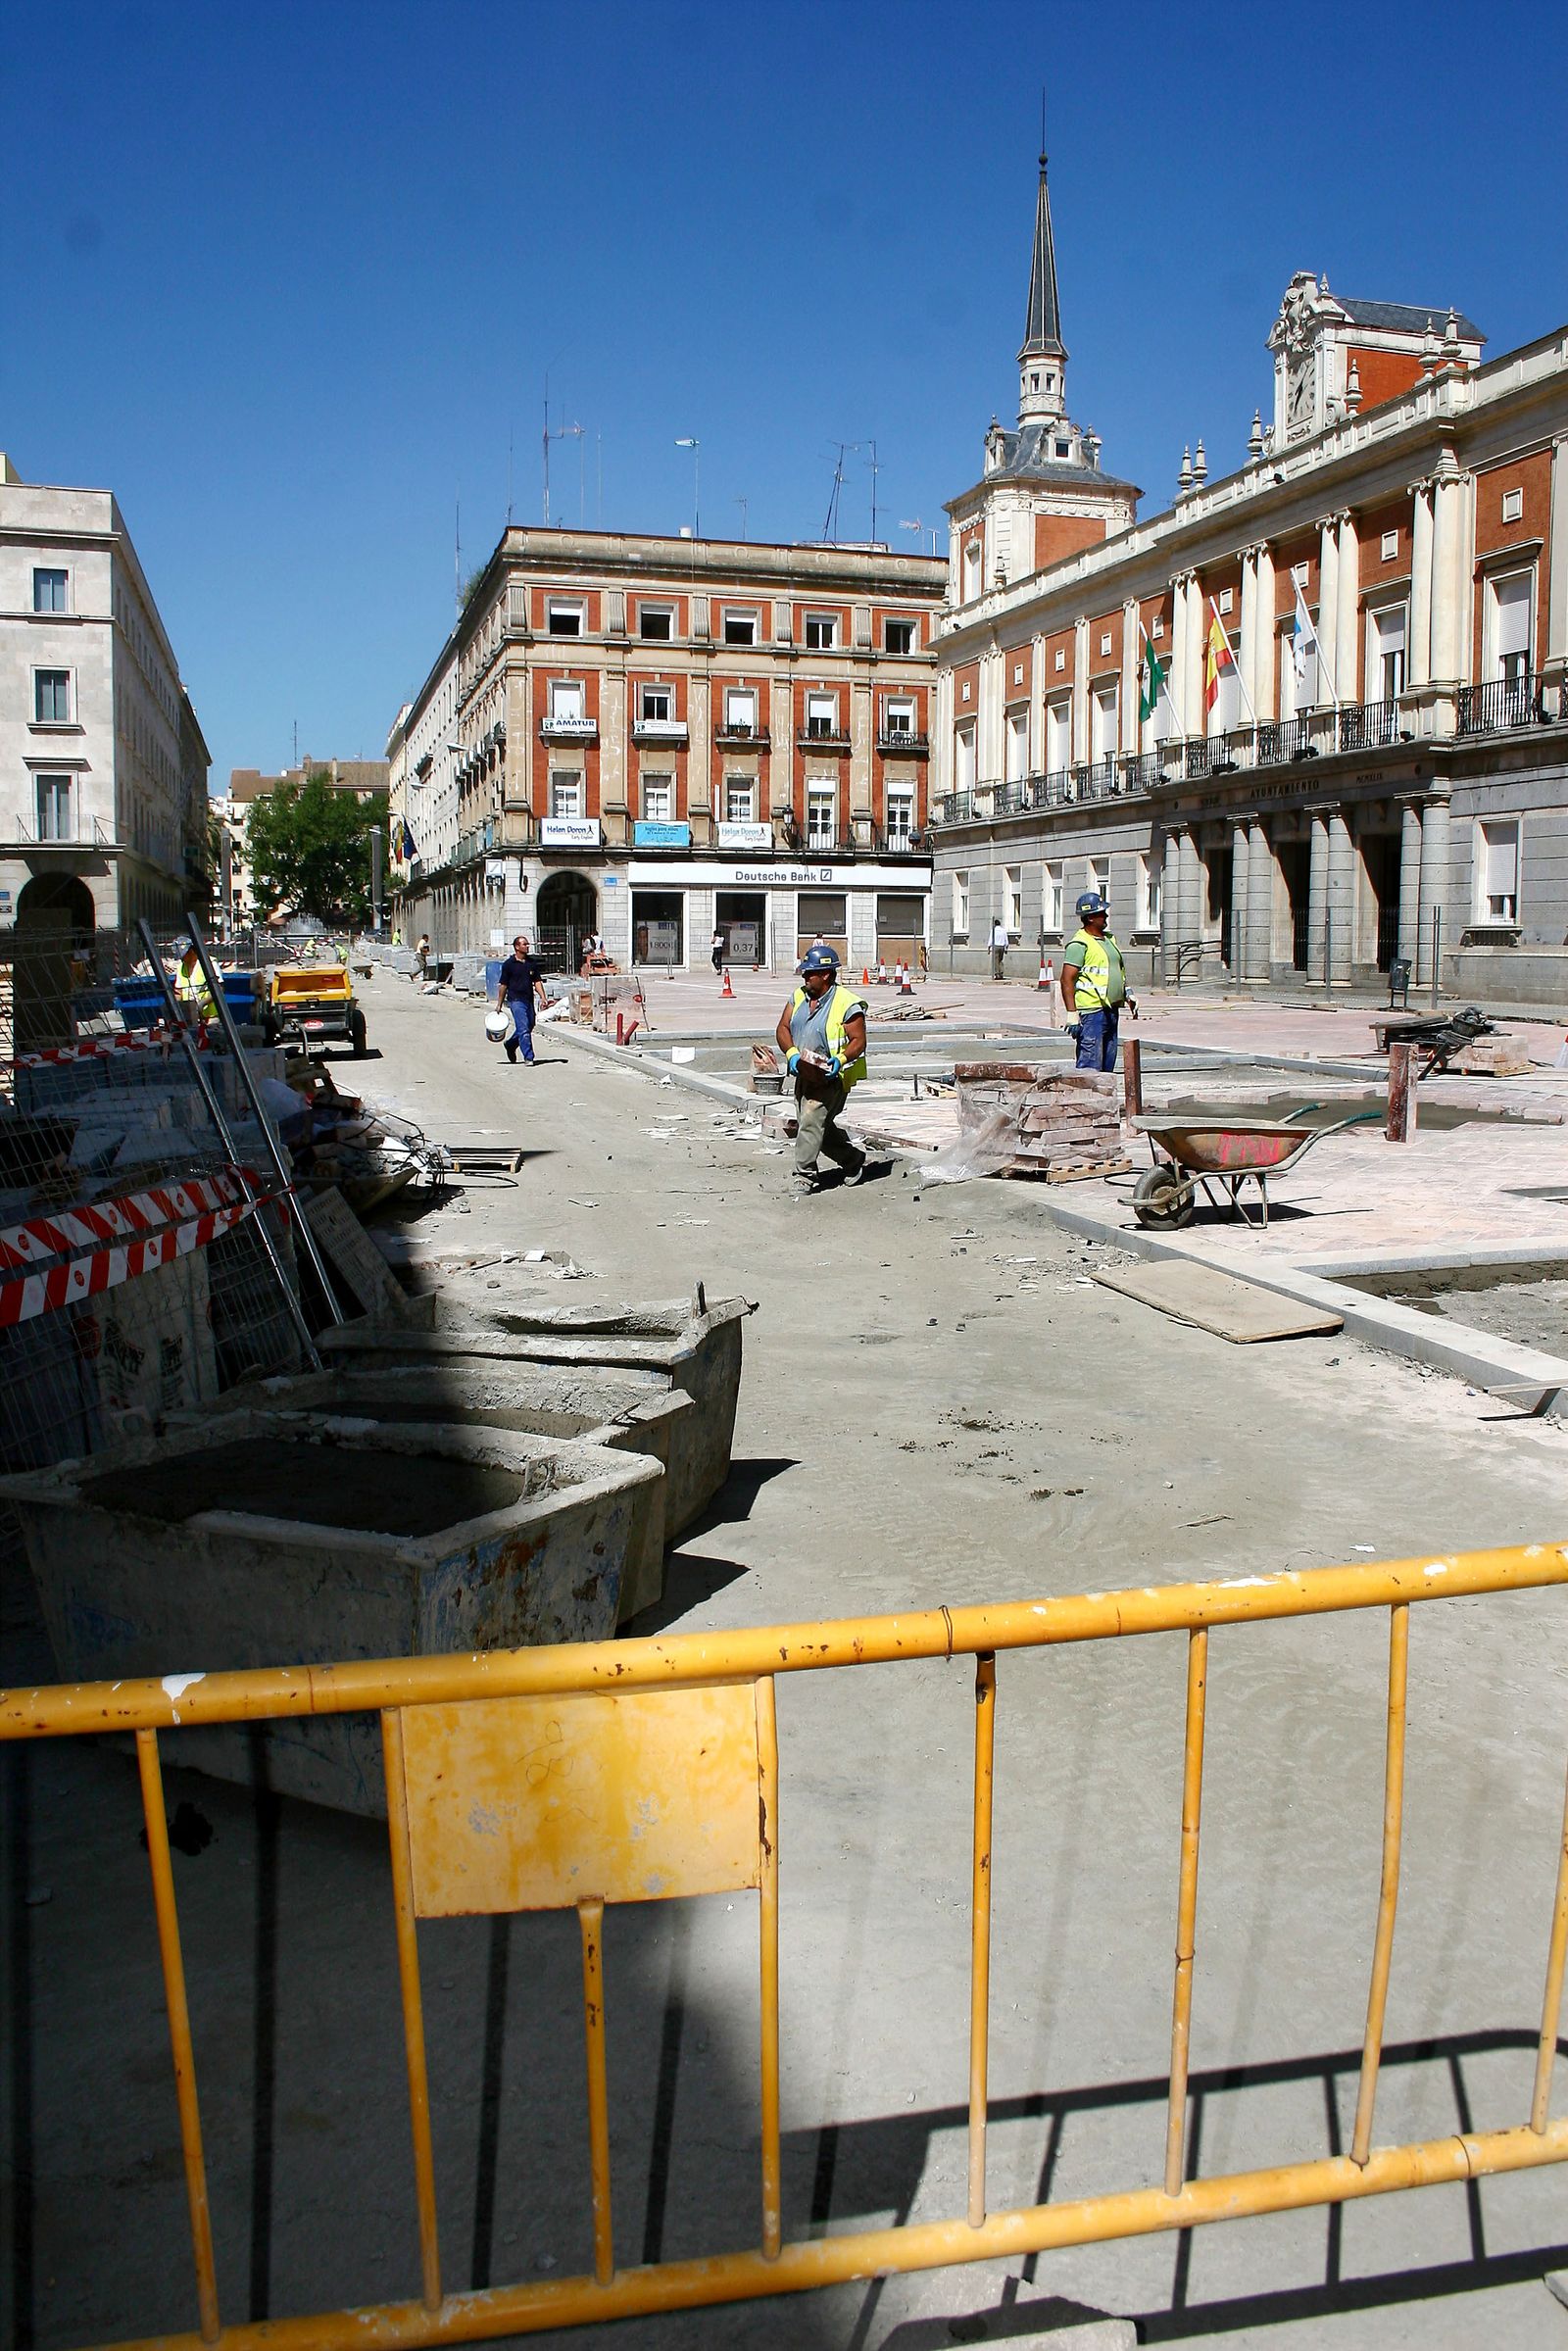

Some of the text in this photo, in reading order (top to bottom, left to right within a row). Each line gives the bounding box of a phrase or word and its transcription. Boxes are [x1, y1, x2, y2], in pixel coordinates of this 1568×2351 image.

[1250, 779, 1320, 799] AYUNTAMIENTO
[735, 871, 817, 881] Deutsche Bank
